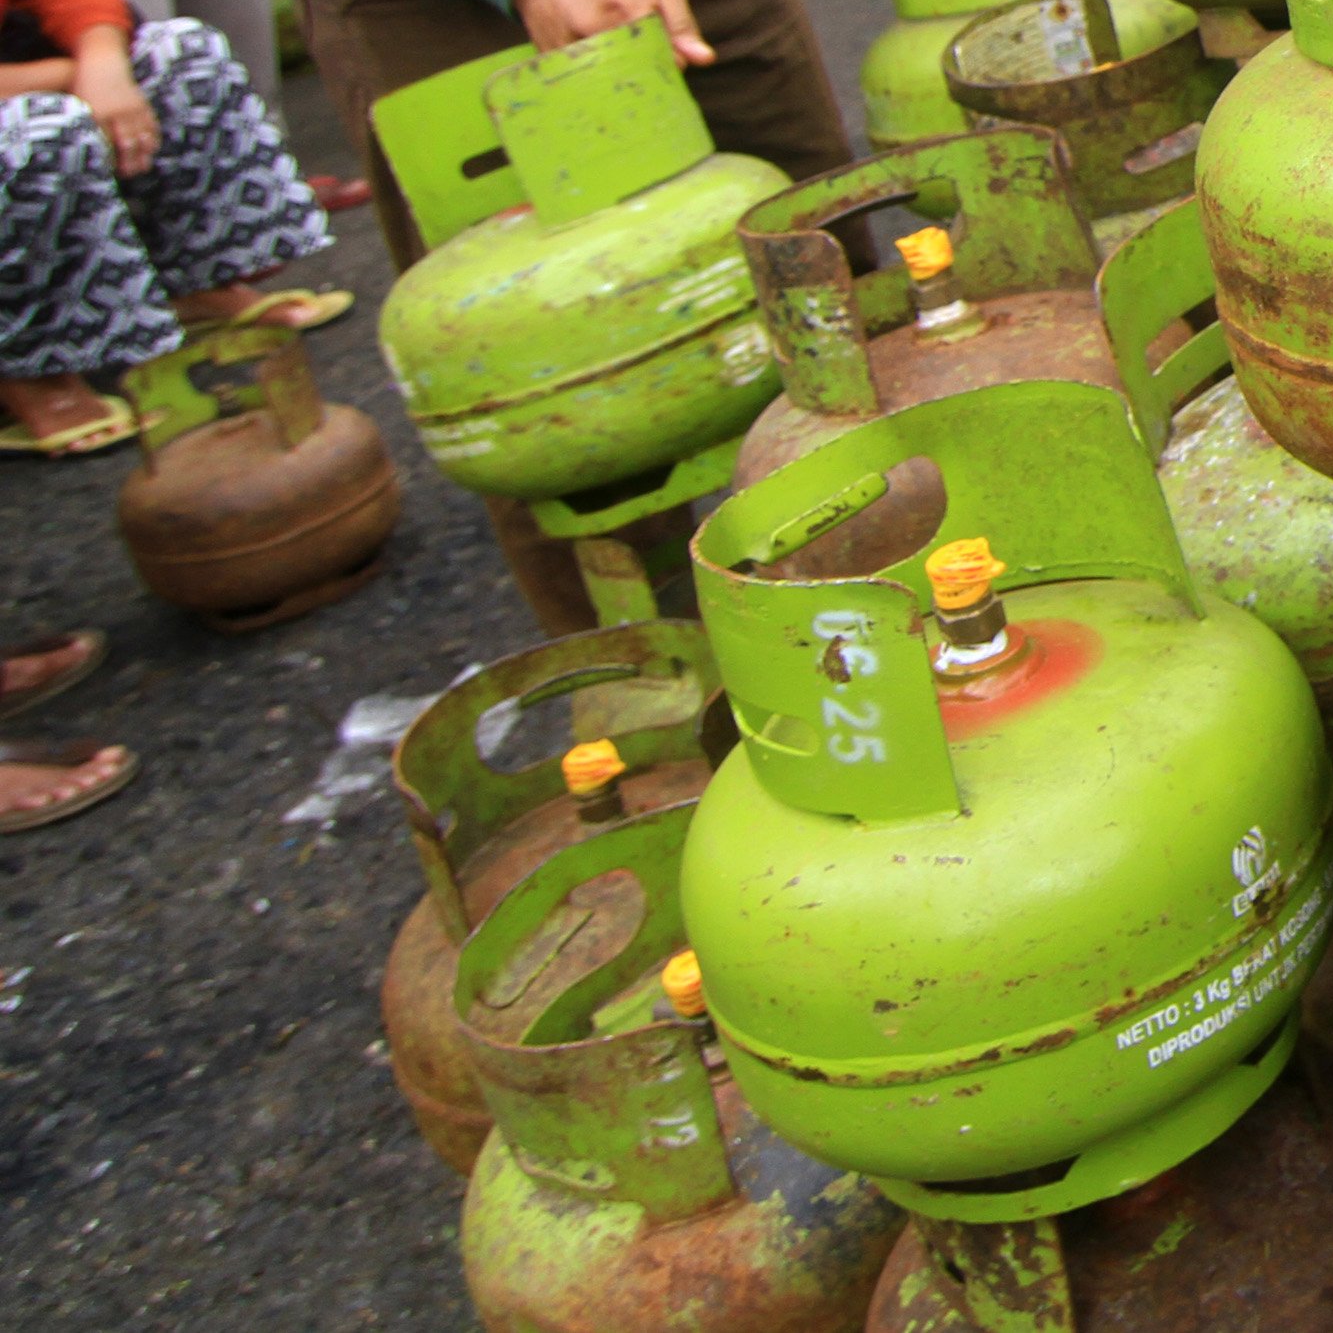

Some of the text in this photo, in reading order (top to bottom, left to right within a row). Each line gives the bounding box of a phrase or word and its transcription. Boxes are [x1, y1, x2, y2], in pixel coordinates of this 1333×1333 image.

[1116, 1004, 1181, 1051] NETTO
[1192, 988, 1206, 1013] 3
[1205, 978, 1233, 1004] Kg
[1147, 989, 1252, 1068] DIPRODUKSI
